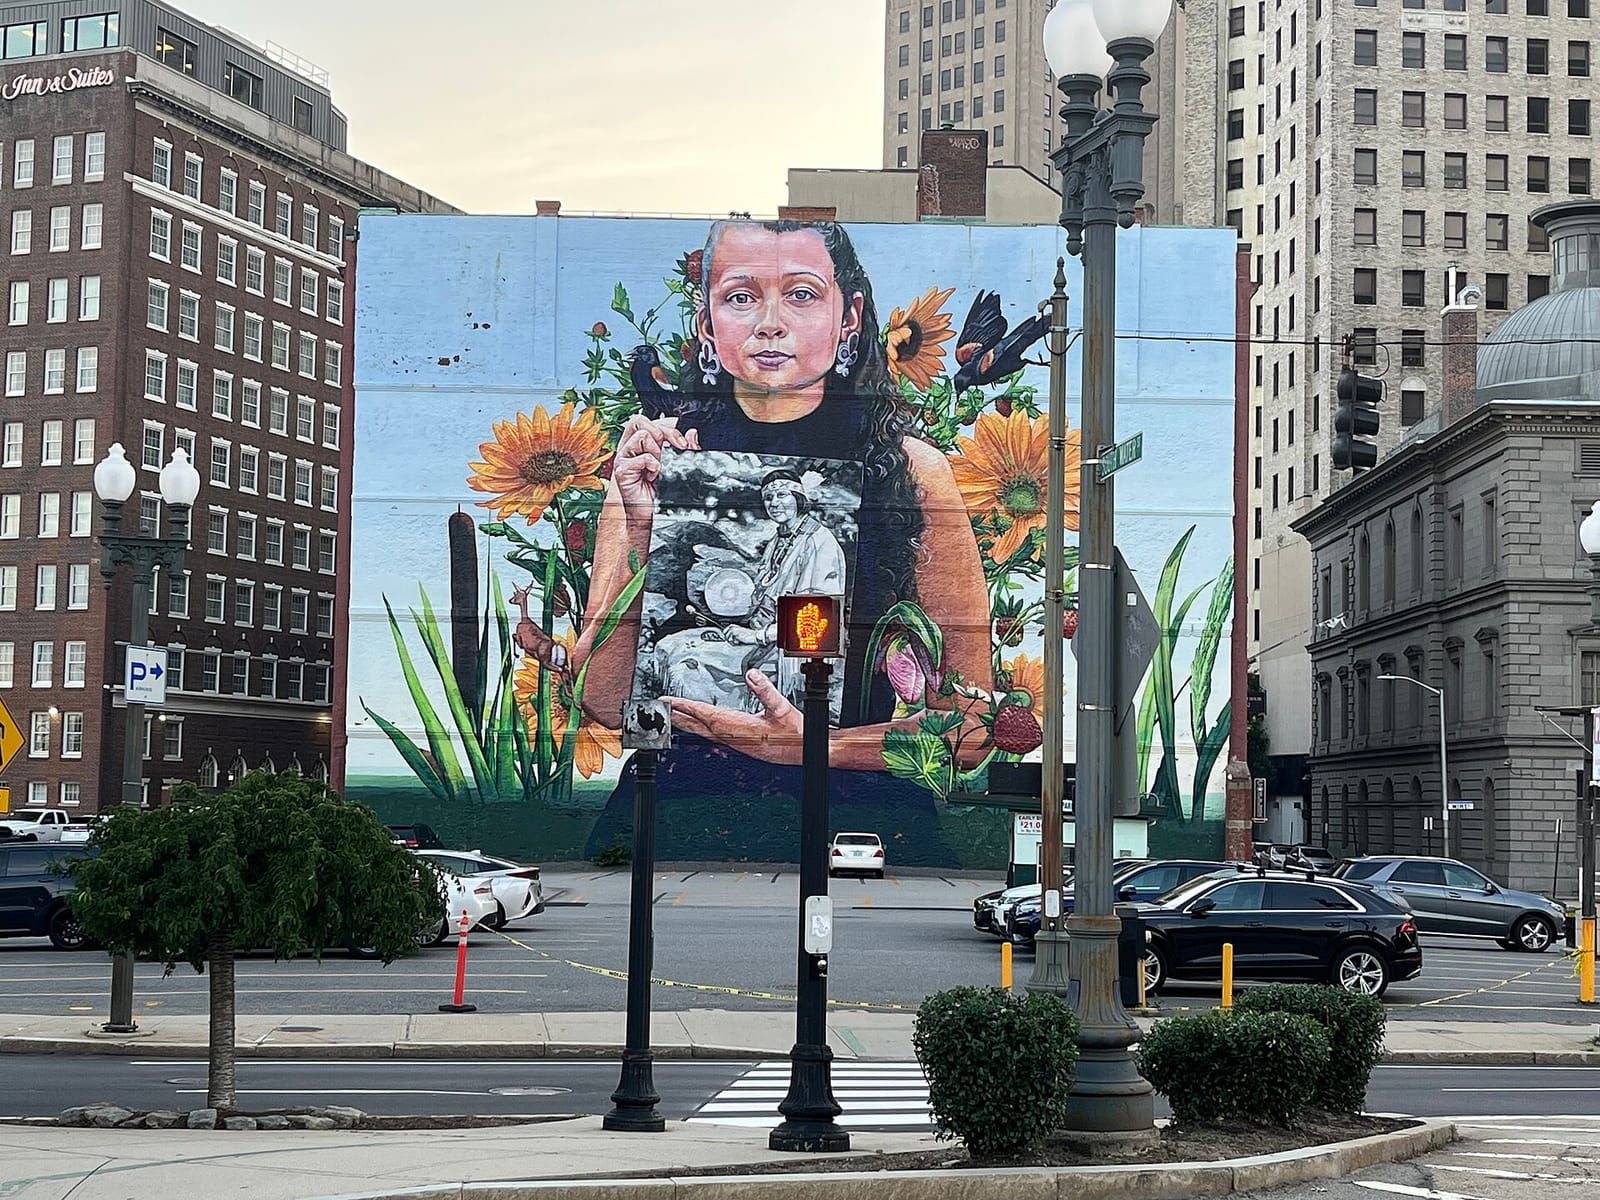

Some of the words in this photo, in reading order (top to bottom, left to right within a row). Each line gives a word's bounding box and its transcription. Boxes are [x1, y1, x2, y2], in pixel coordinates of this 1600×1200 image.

[2, 74, 50, 100] Inn
[61, 67, 114, 91] Suites
[131, 662, 146, 690] P
[1020, 821, 1041, 829] $21.0
